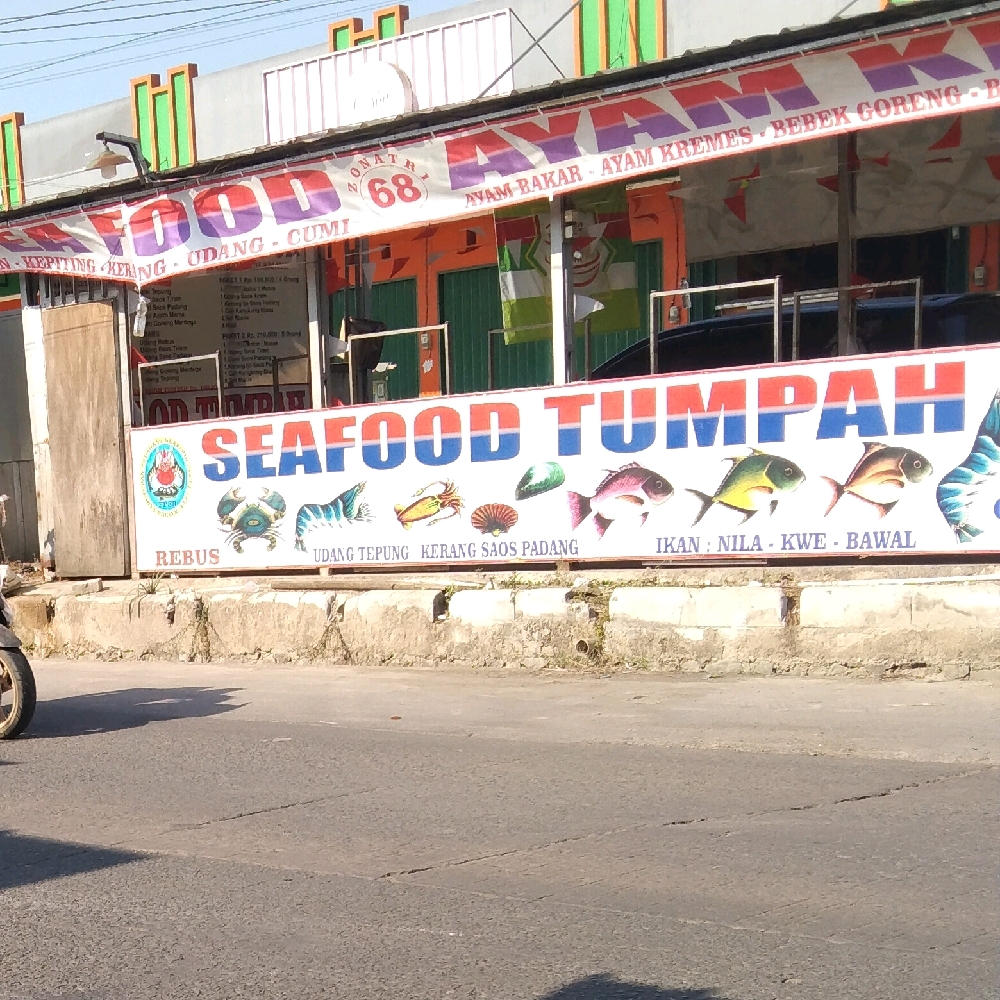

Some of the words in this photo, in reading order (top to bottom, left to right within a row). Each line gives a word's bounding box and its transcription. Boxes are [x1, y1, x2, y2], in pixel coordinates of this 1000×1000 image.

[445, 62, 820, 191] AYAM
[465, 184, 513, 208] AYAM
[517, 164, 582, 196] BAKAR
[601, 147, 653, 177] AYAM
[660, 125, 754, 163] KREMES
[769, 106, 852, 139] BEBEK
[857, 85, 963, 122] GORENG
[87, 168, 341, 257] FOOD
[366, 173, 423, 208] 68
[23, 254, 96, 273] KEPITING
[107, 259, 166, 281] KERANG
[187, 237, 265, 267] UDANG
[288, 218, 350, 246] CUMI
[201, 402, 520, 482] SEAFOOD
[543, 361, 965, 456] TUMPAH
[155, 548, 220, 568] REBUS
[313, 546, 355, 563] UDANG
[358, 545, 409, 561] TEPUNG
[421, 542, 477, 559] KERANG
[481, 540, 519, 558] SAOS
[521, 538, 579, 557] PADANG
[655, 537, 700, 554] IKAN
[717, 534, 764, 552] NILA
[780, 532, 827, 551] KWE
[845, 530, 917, 550] BAWAL
